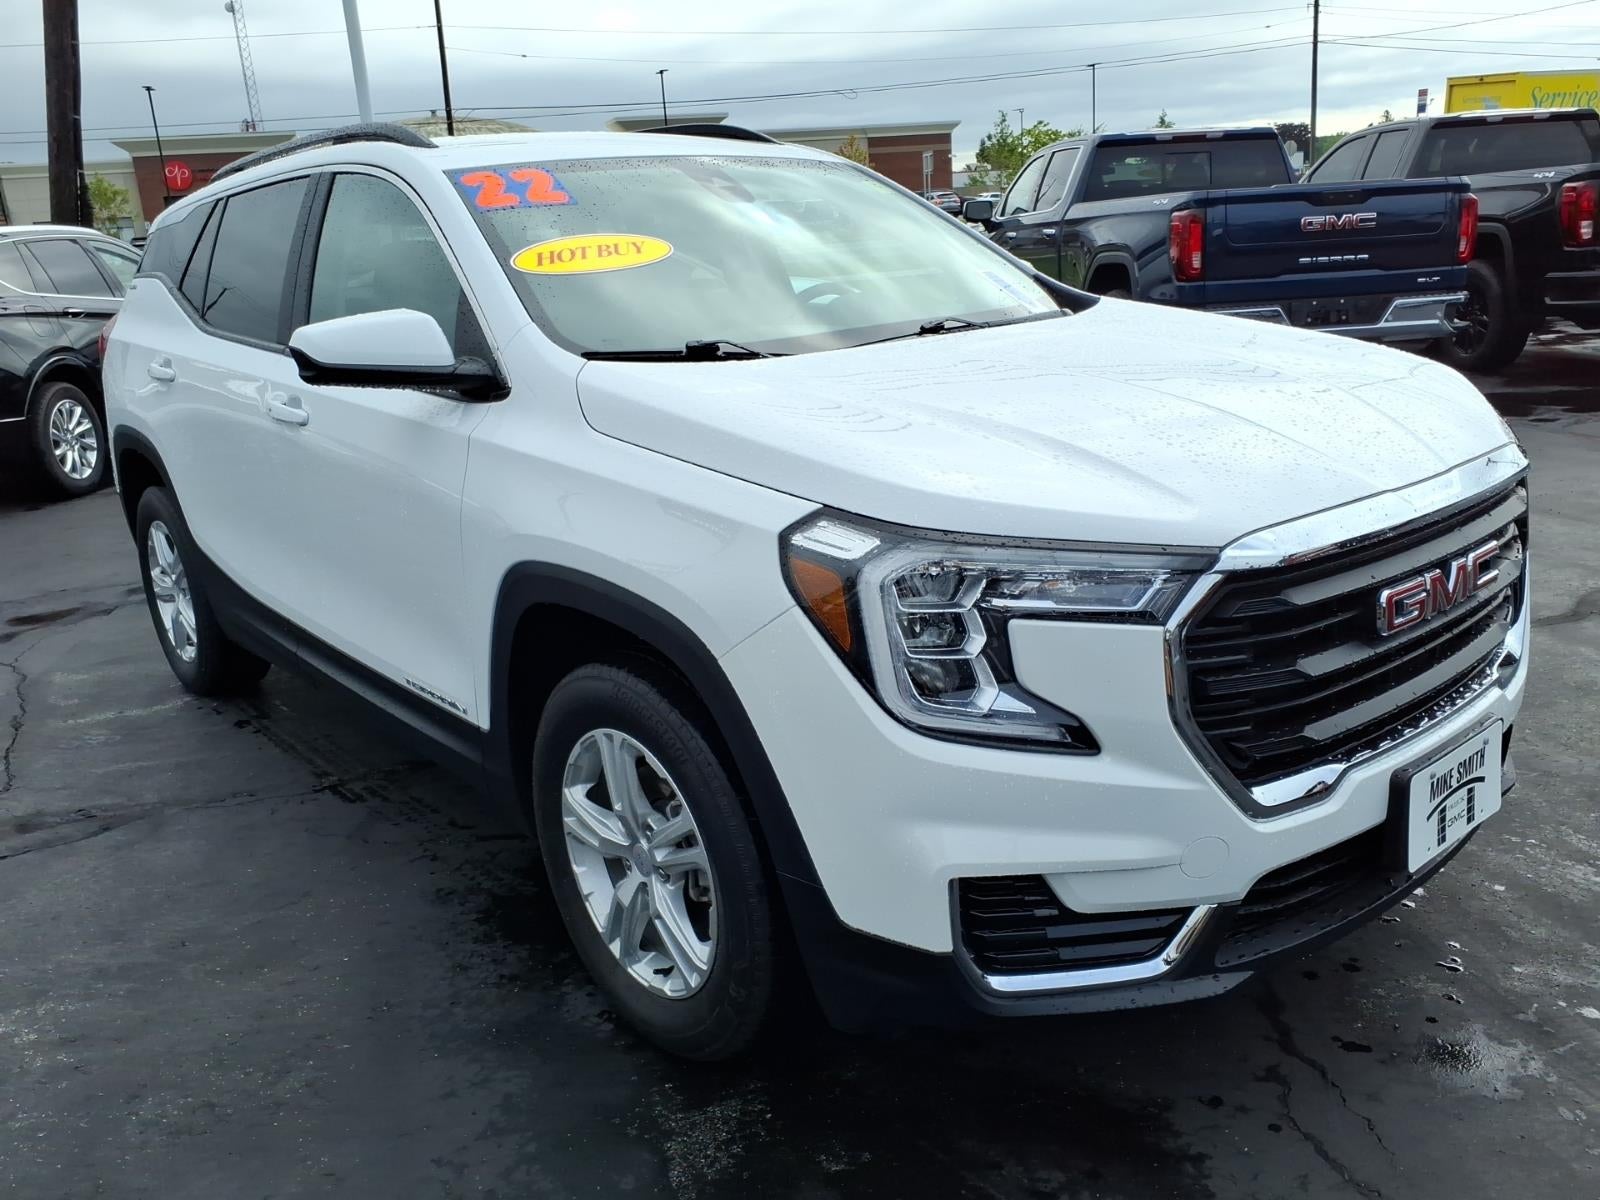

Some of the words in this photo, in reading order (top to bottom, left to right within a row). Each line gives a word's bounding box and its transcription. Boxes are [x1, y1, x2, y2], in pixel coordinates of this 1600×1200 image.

[460, 167, 571, 209] 22
[1301, 212, 1377, 232] GMC
[536, 245, 592, 267] HOT
[597, 241, 645, 259] BUY
[1298, 254, 1369, 264] SIERRA
[1376, 540, 1500, 636] GMC
[1429, 767, 1455, 803] MIKE
[1456, 745, 1486, 784] SMITH
[1447, 809, 1466, 828] GMC
